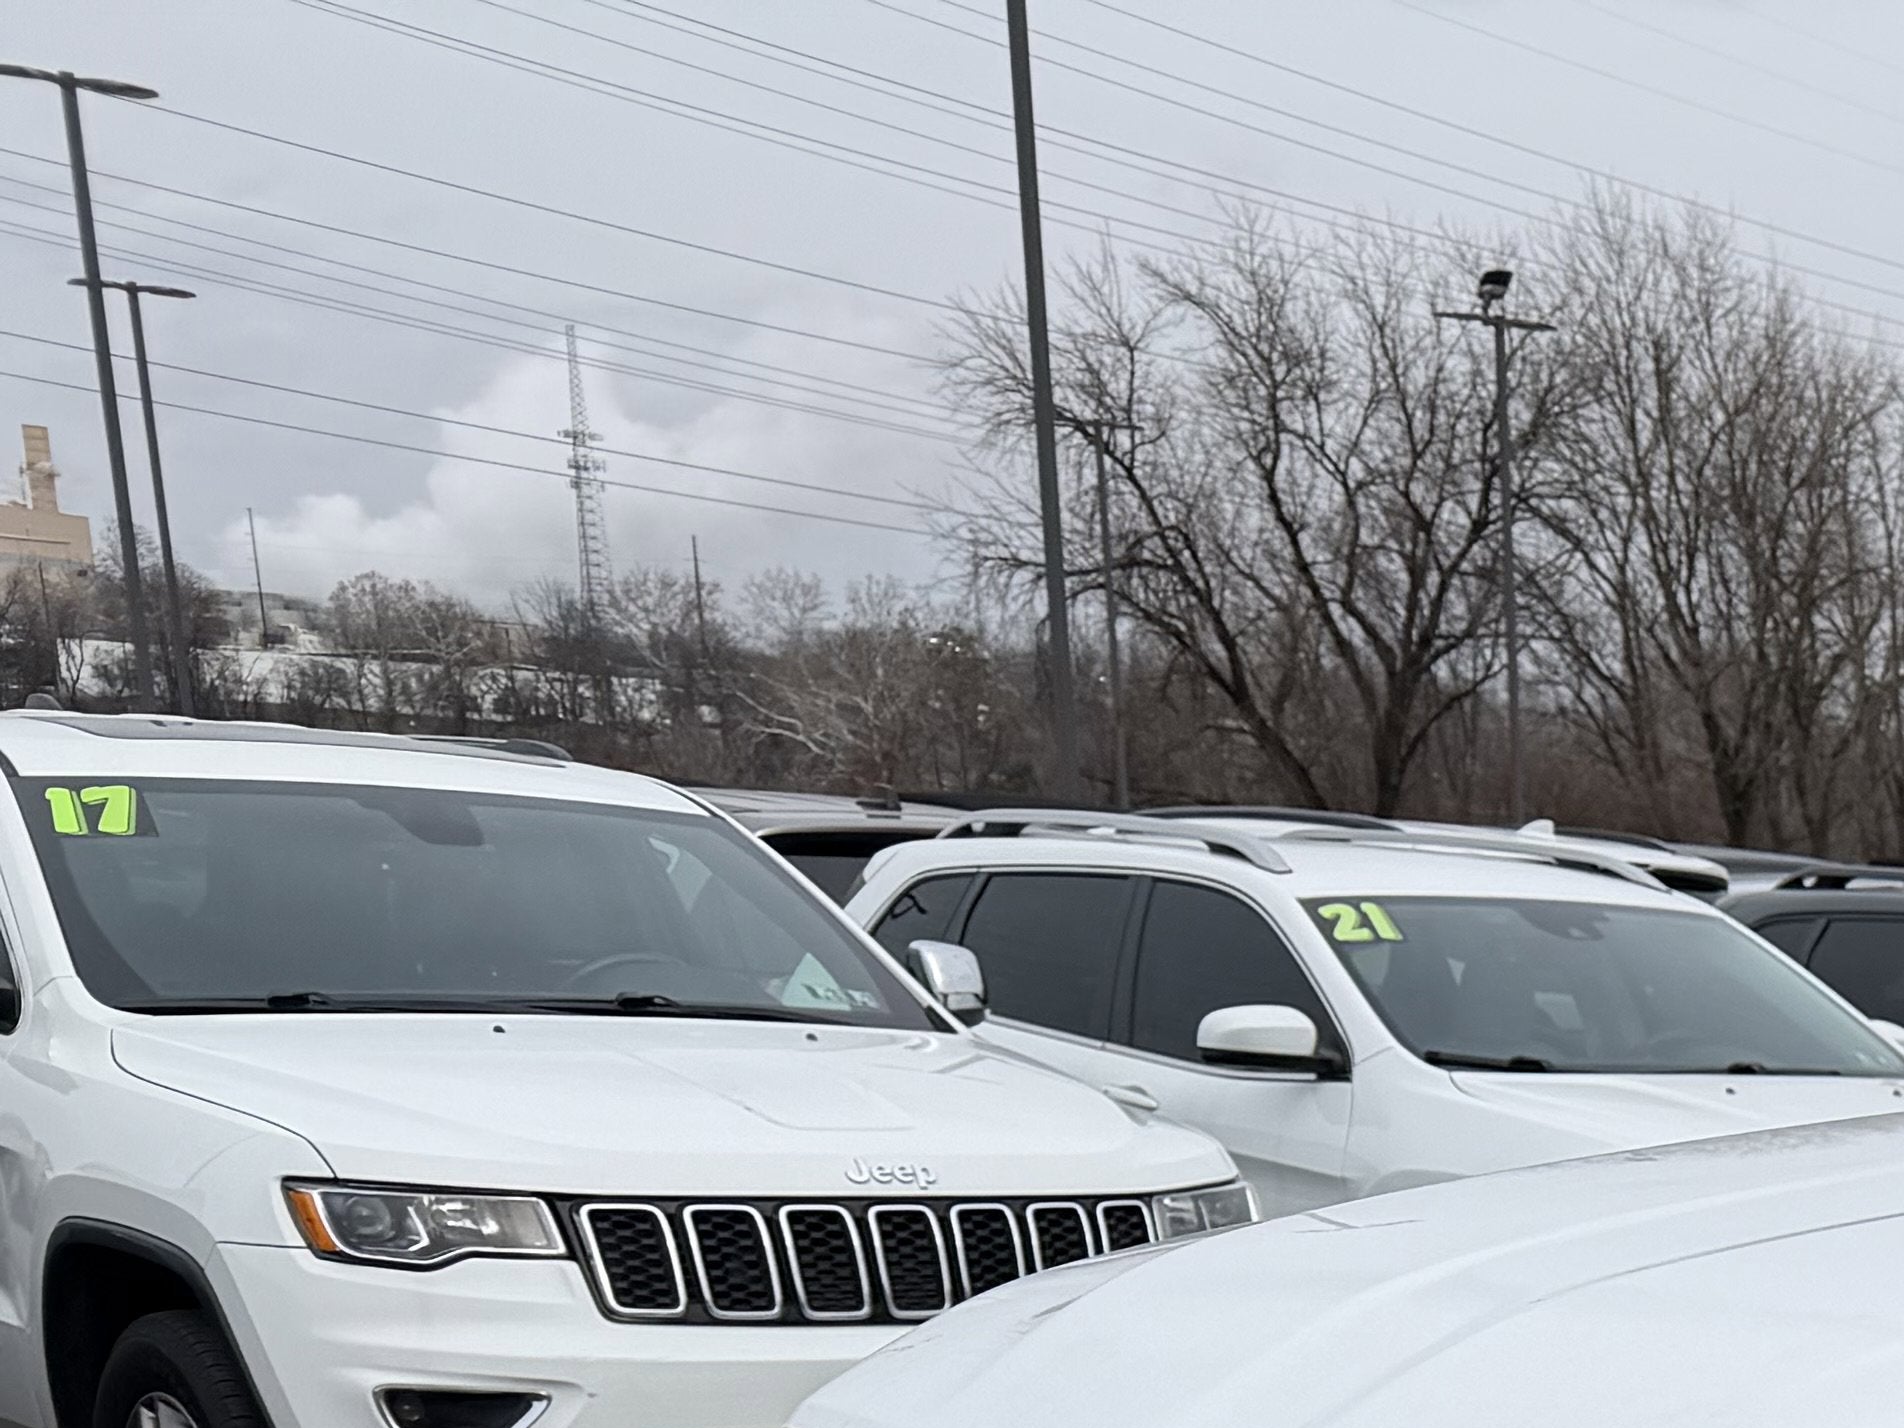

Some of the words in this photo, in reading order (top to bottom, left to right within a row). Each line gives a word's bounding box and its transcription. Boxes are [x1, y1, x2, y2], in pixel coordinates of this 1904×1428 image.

[45, 785, 137, 836] 17
[1317, 902, 1404, 942] 21
[844, 1157, 937, 1190] Jeep
